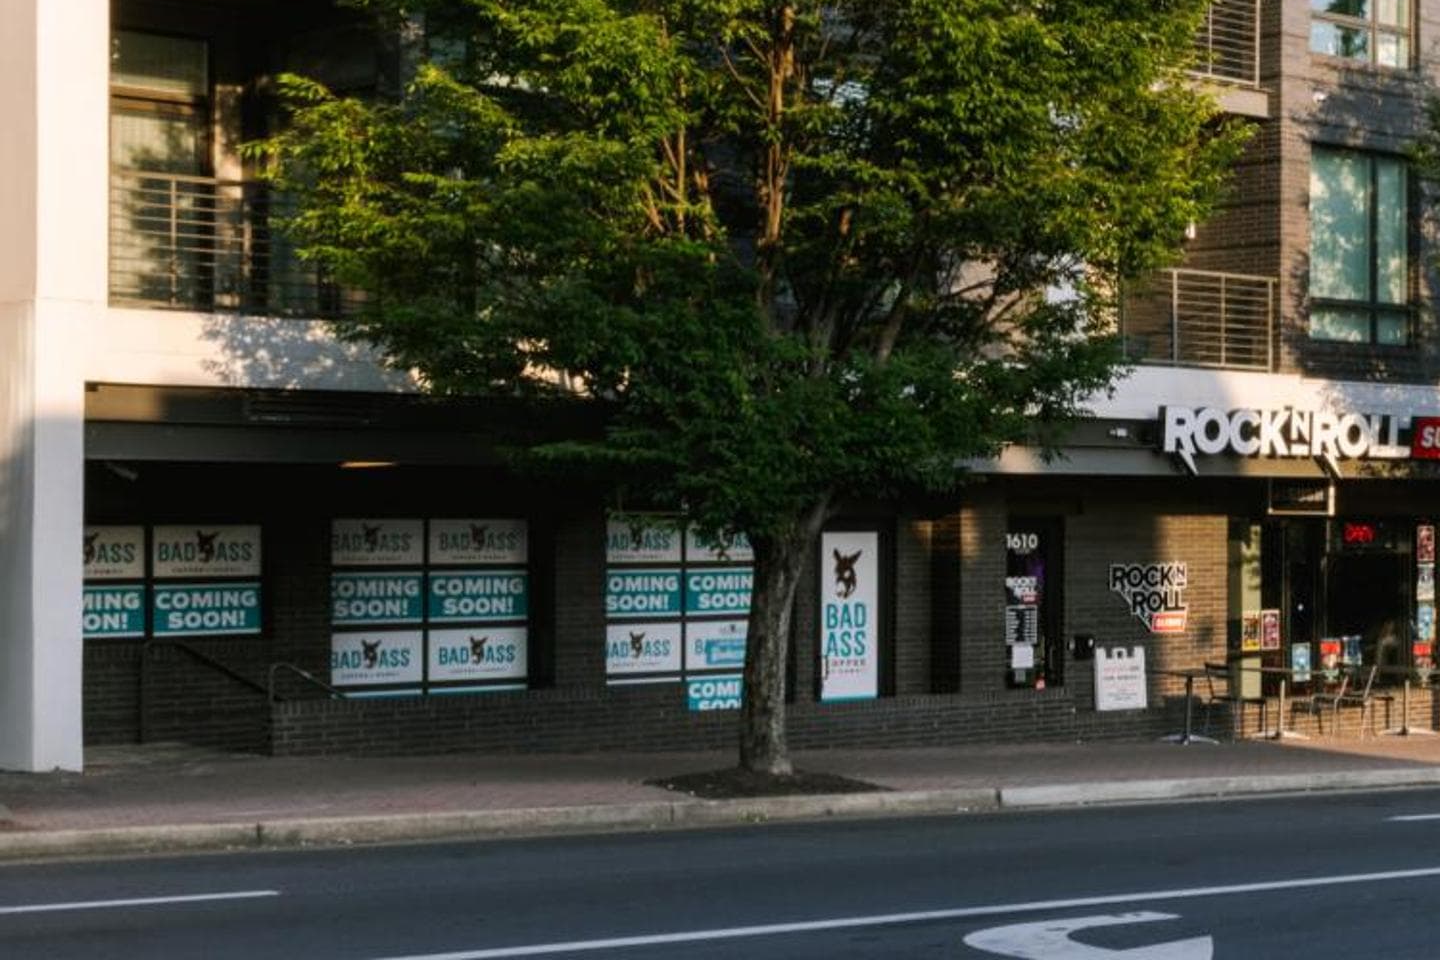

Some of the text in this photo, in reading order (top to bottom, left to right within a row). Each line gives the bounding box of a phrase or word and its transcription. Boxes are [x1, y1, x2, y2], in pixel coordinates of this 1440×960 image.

[1165, 406, 1290, 476] ROCK
[1311, 410, 1410, 478] ROLL
[380, 531, 413, 551] ASS
[439, 530, 520, 551] BAD ASS
[1006, 533, 1038, 549] 1610
[96, 542, 136, 563] ASS
[158, 541, 253, 563] BAD ASS
[431, 577, 524, 596] COMING
[609, 575, 679, 593] OMING
[1112, 566, 1173, 592] ROCK
[83, 591, 140, 611] MING
[155, 590, 258, 610] COMING
[334, 598, 409, 617] SOON!
[442, 596, 514, 615] SOON!
[606, 593, 669, 611] SOON!
[1132, 591, 1186, 616] ROLL
[83, 612, 128, 631] ON!
[167, 610, 246, 629] SOON!
[826, 603, 866, 629] BAD
[644, 638, 671, 657] ASS
[826, 631, 866, 657] ASS
[379, 648, 411, 668] ASS
[439, 644, 517, 665] BAD ASS
